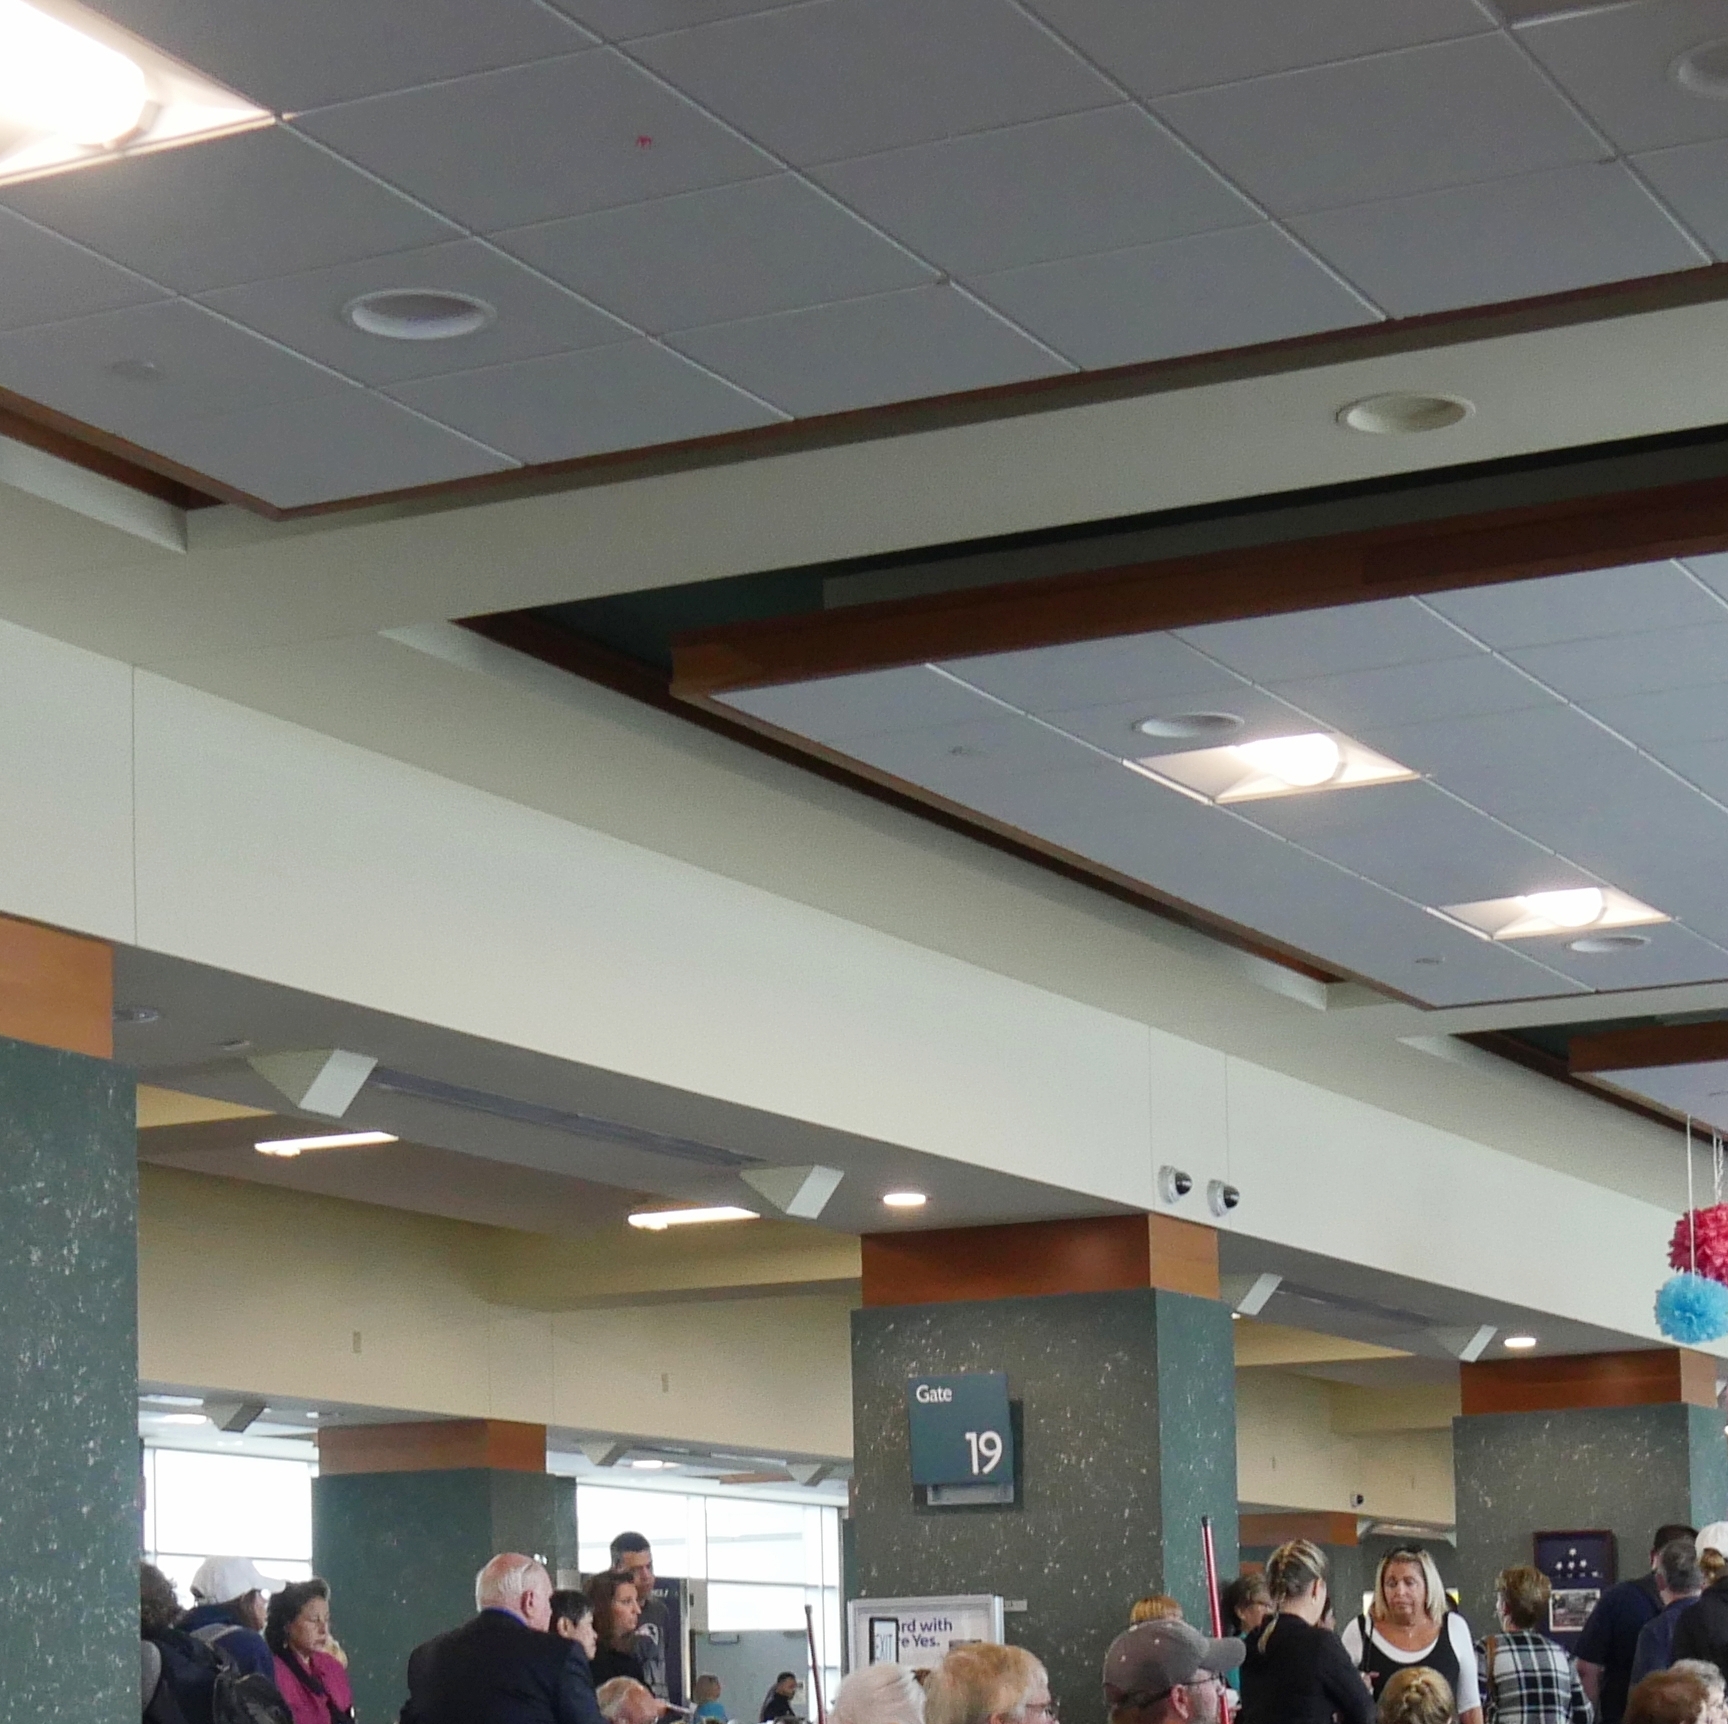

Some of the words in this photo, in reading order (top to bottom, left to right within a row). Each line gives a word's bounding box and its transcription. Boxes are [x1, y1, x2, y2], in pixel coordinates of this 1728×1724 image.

[915, 1384, 953, 1404] Gate
[964, 1430, 1003, 1476] 19
[920, 1617, 953, 1633] with
[912, 1634, 940, 1648] Yes.
